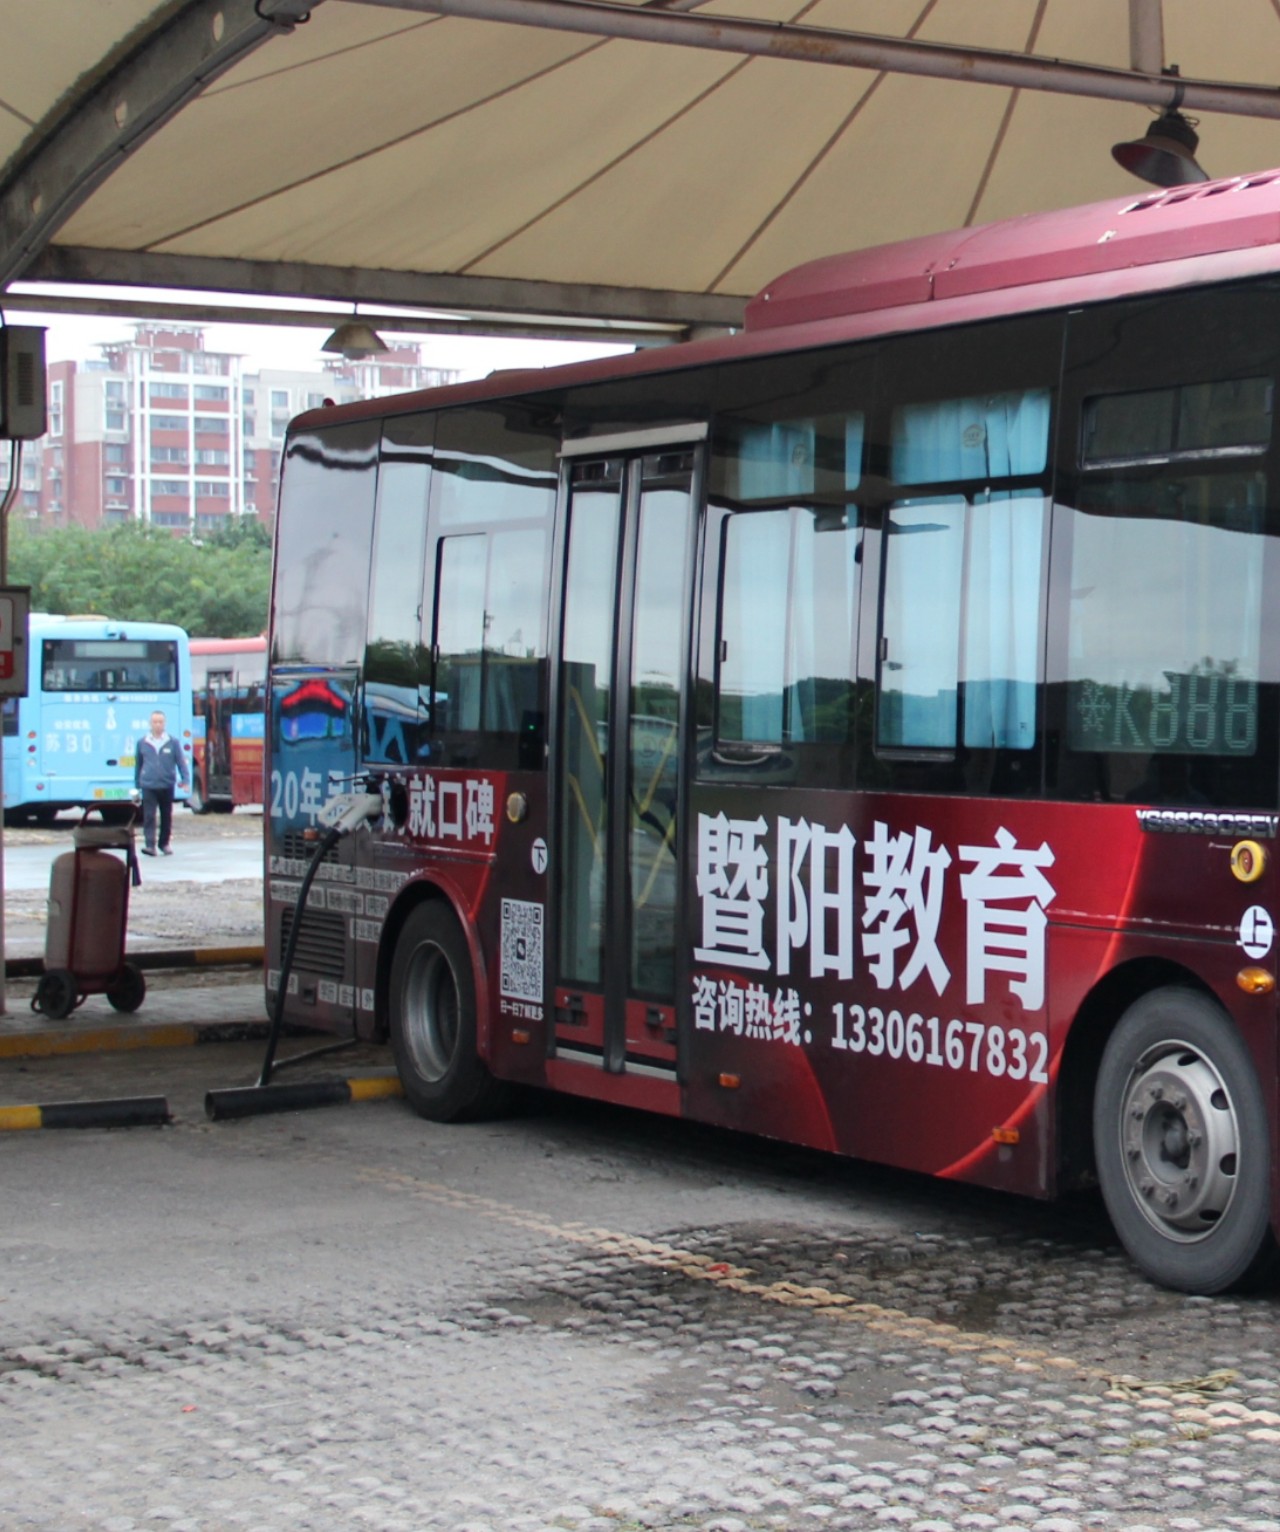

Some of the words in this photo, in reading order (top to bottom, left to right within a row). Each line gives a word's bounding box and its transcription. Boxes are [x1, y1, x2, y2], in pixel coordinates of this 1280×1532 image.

[533, 845, 547, 872] 下
[693, 810, 1056, 1011] 暨阳教育
[1243, 908, 1269, 949] 上
[692, 975, 814, 1047] 咨询热线：
[831, 1002, 1049, 1084] 13306167832
